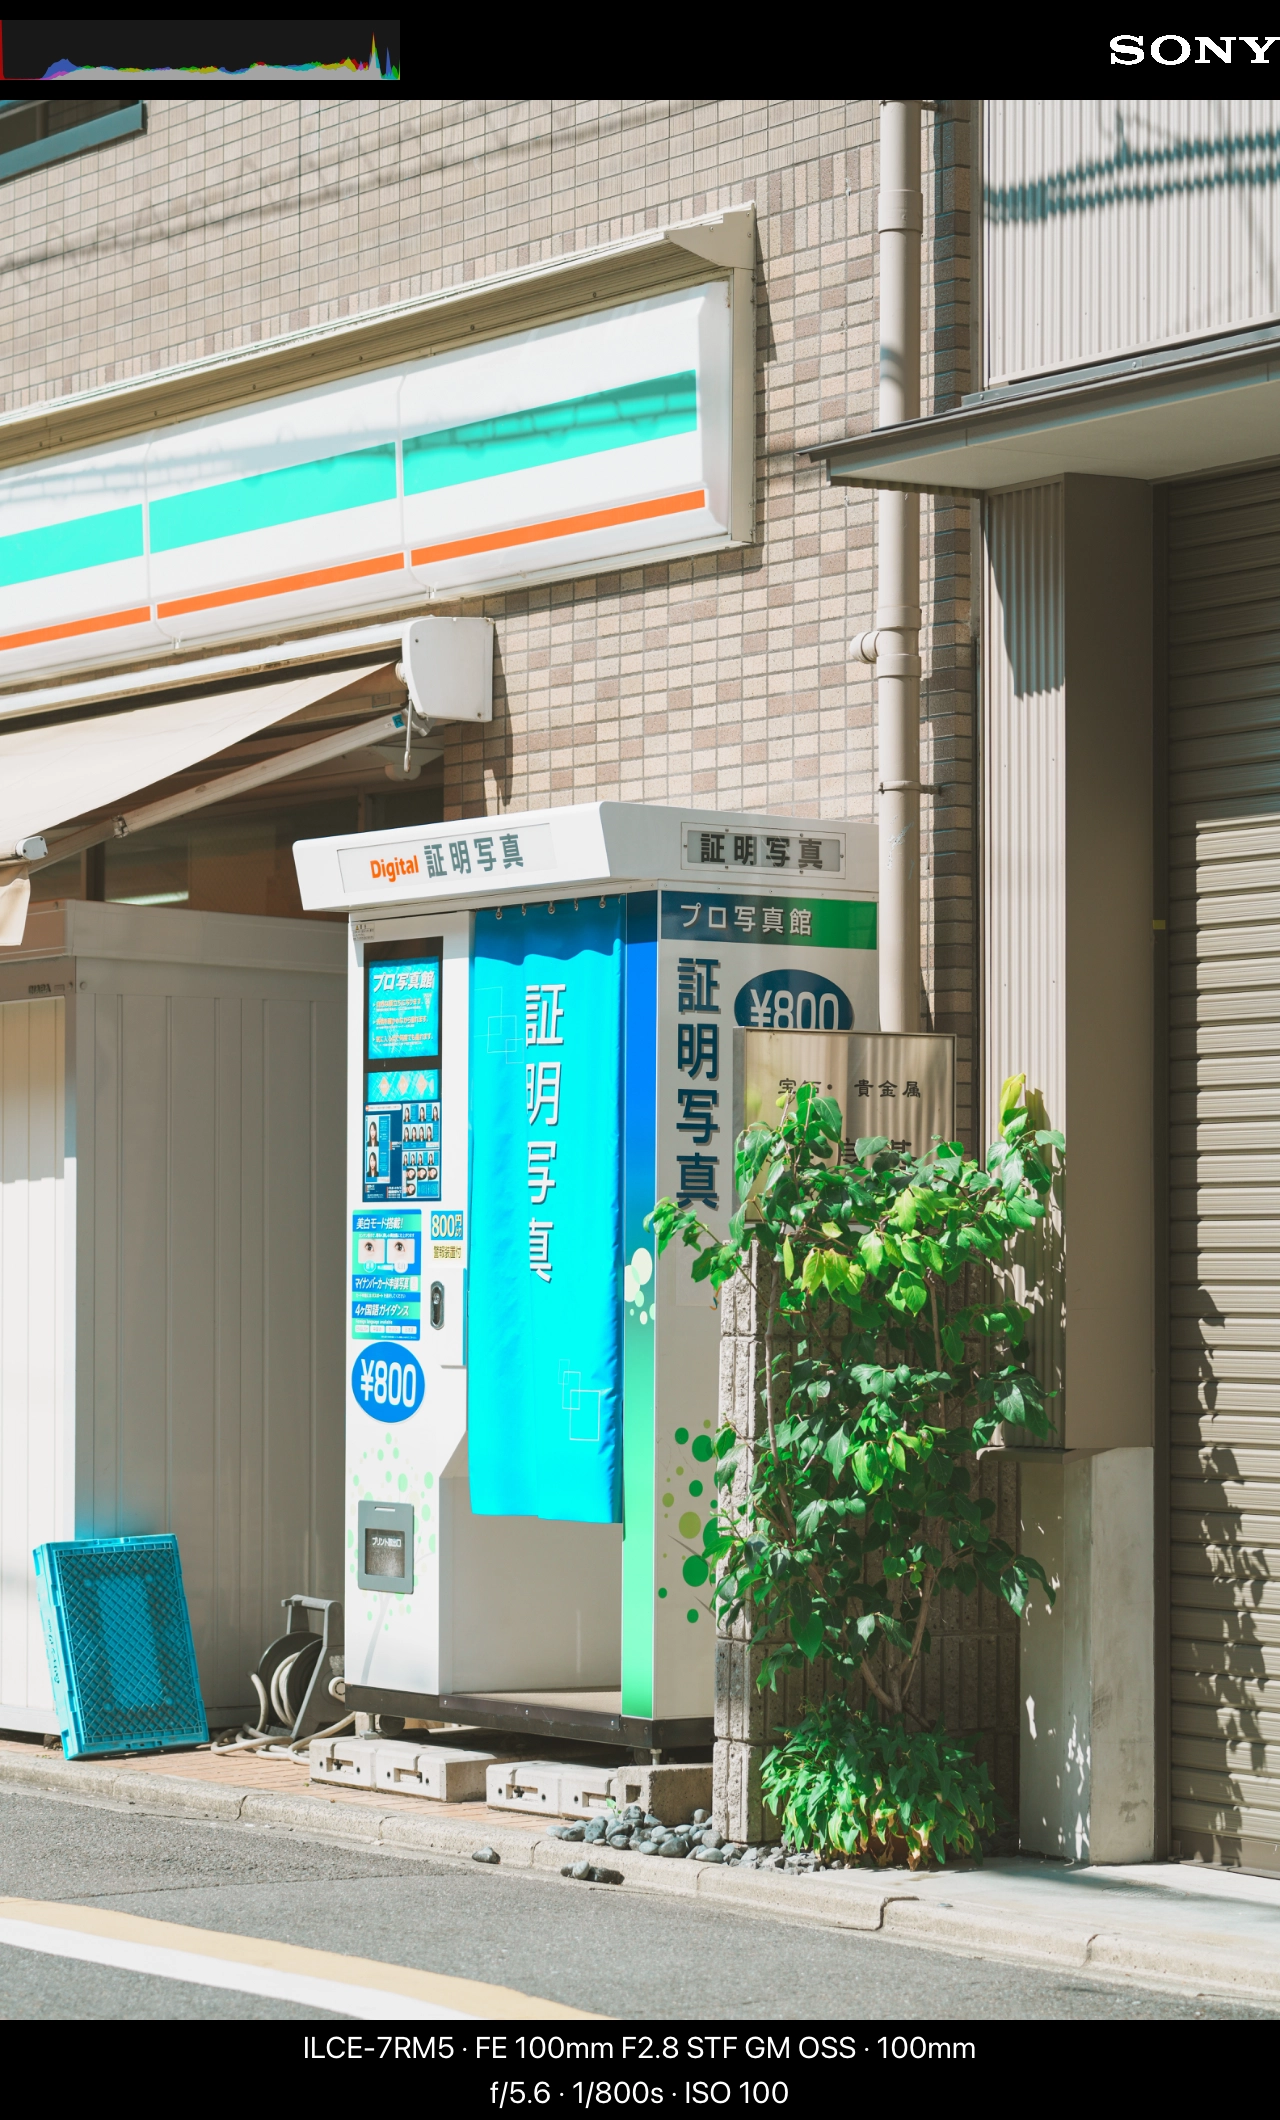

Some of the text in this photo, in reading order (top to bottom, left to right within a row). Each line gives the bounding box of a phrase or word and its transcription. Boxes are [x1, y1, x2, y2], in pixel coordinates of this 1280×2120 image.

[370, 833, 524, 883] Digital 証明写真
[701, 833, 823, 870] 証明写真
[681, 902, 813, 936] プロ写真館
[373, 971, 435, 993] プロ写真館
[750, 989, 839, 1029] ¥800
[676, 957, 720, 1210] 証明写真
[525, 983, 567, 1284] 証明写真
[360, 1358, 417, 1408] ¥800
